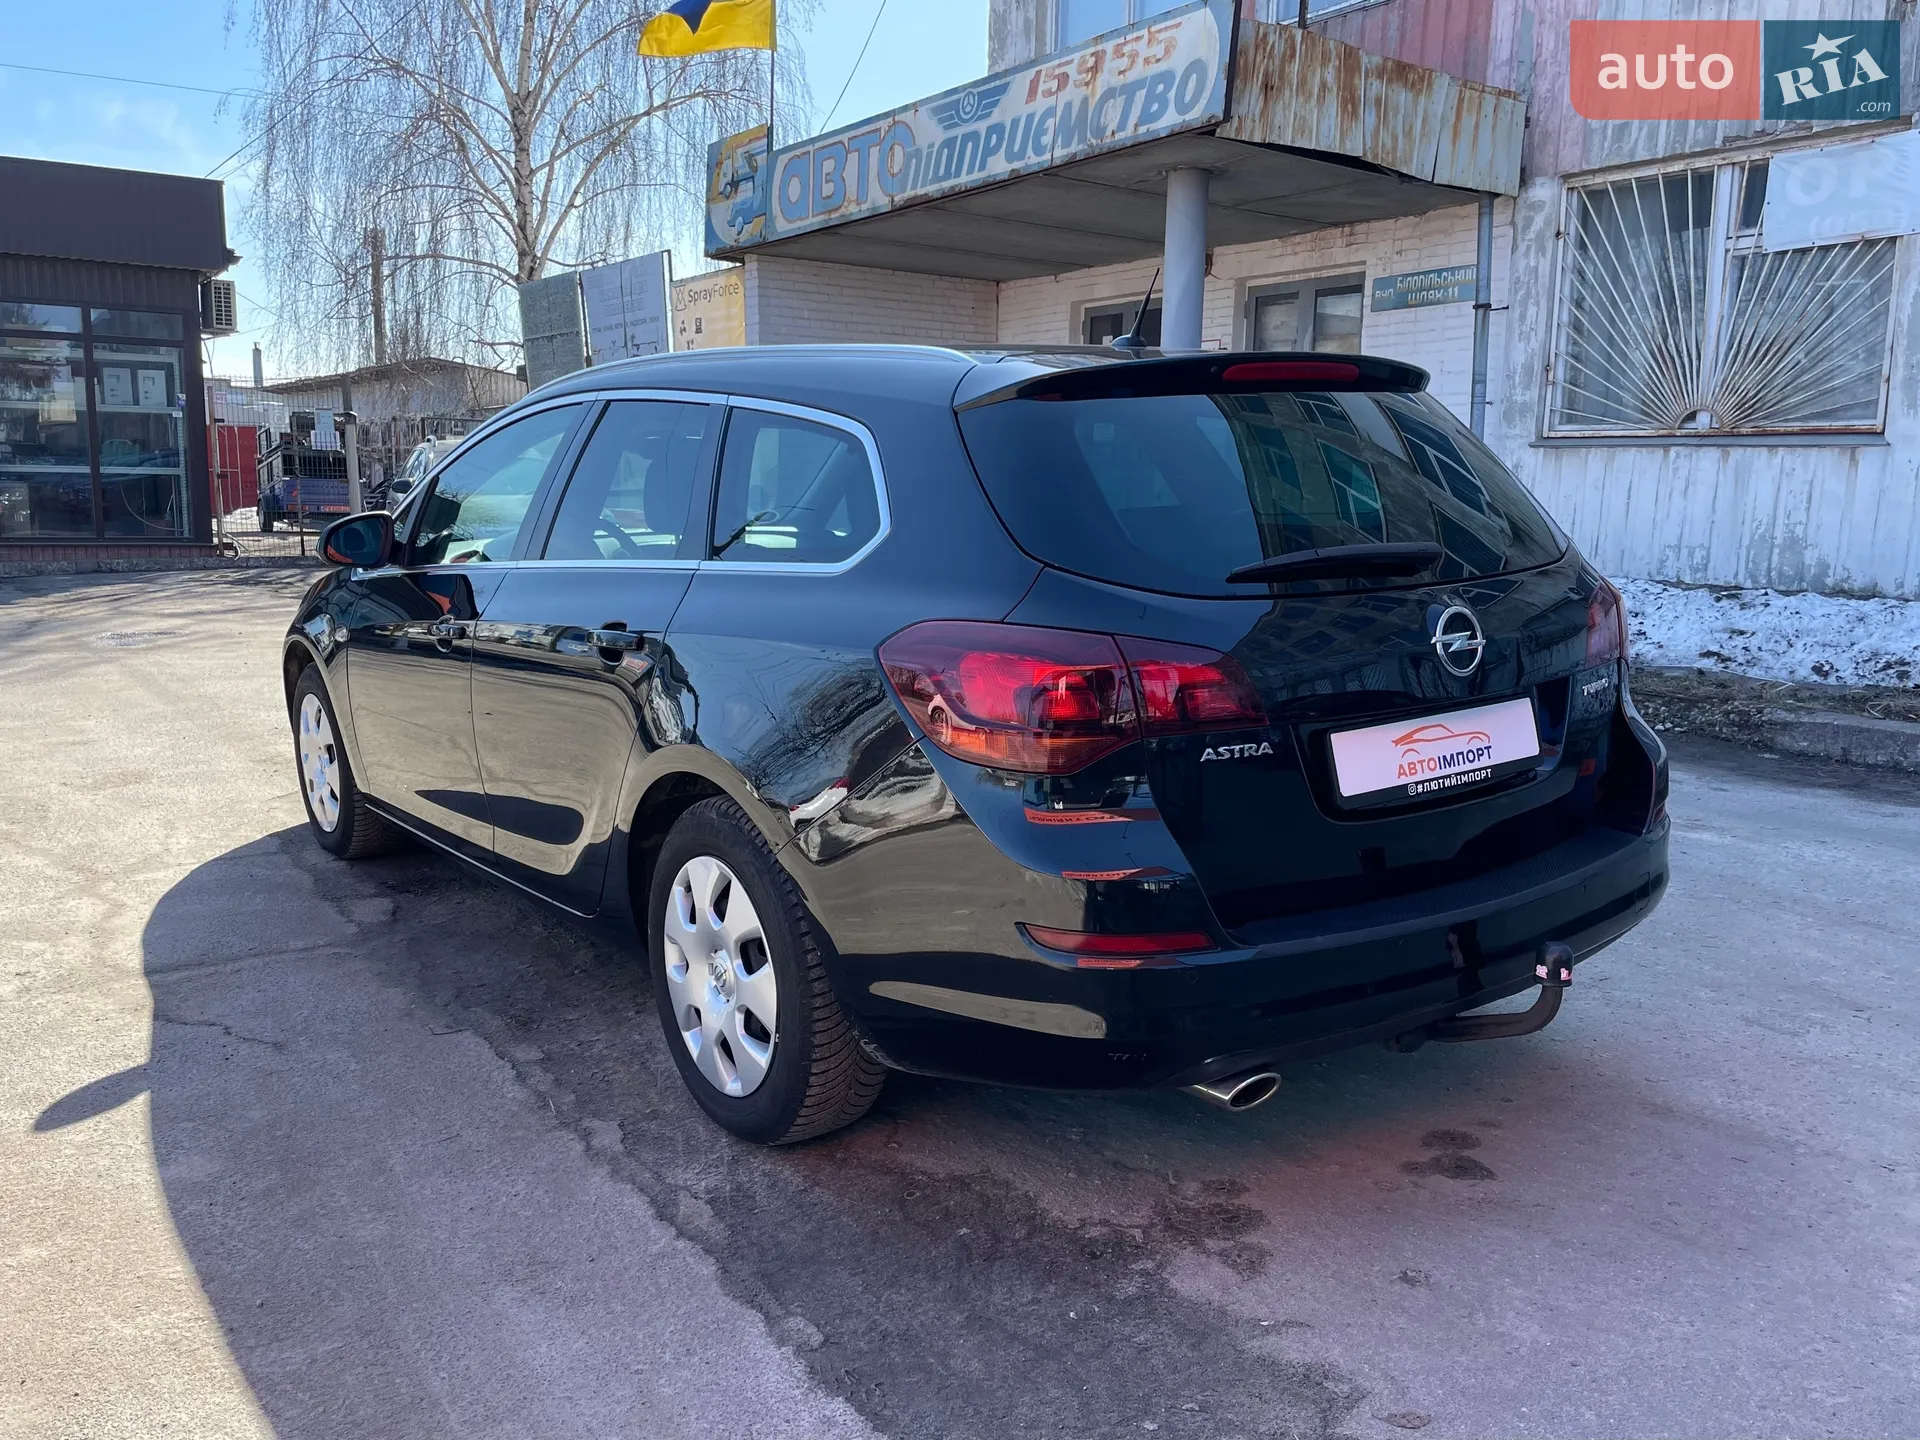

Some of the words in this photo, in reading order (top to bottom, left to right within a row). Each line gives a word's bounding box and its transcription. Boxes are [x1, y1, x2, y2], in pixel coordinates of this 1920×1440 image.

[1025, 22, 1182, 105] 15955
[688, 283, 740, 306] SprayForce
[1200, 742, 1274, 762] ASTRA
[1397, 745, 1493, 779] АВТОІМПОРТ
